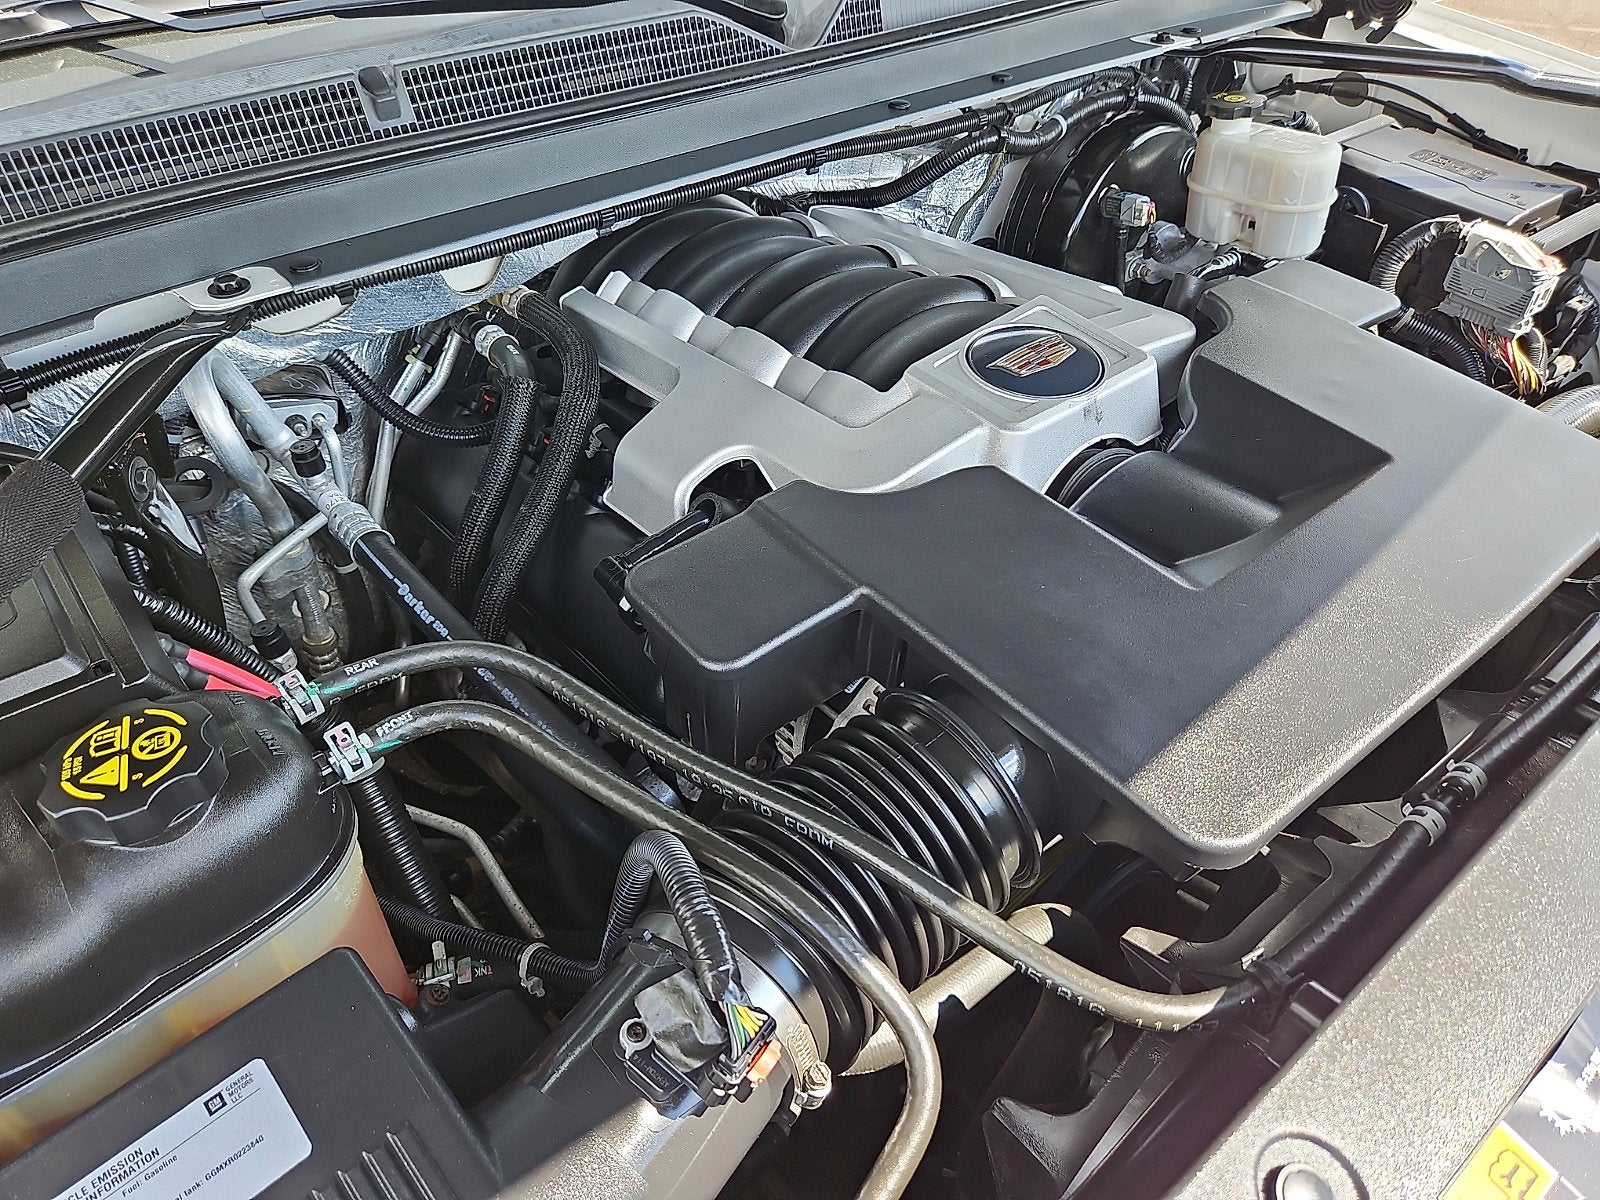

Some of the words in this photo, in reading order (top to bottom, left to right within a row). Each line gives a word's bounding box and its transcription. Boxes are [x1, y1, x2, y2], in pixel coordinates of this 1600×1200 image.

[343, 658, 380, 676] REAR
[375, 710, 413, 738] FRONT
[225, 1071, 253, 1092] GENERAL
[228, 1077, 255, 1097] MOTORS
[230, 1092, 244, 1104] LLC
[91, 1147, 144, 1189] EMISSION
[121, 1179, 143, 1197] Fuel:
[144, 1154, 178, 1181] Gasoline
